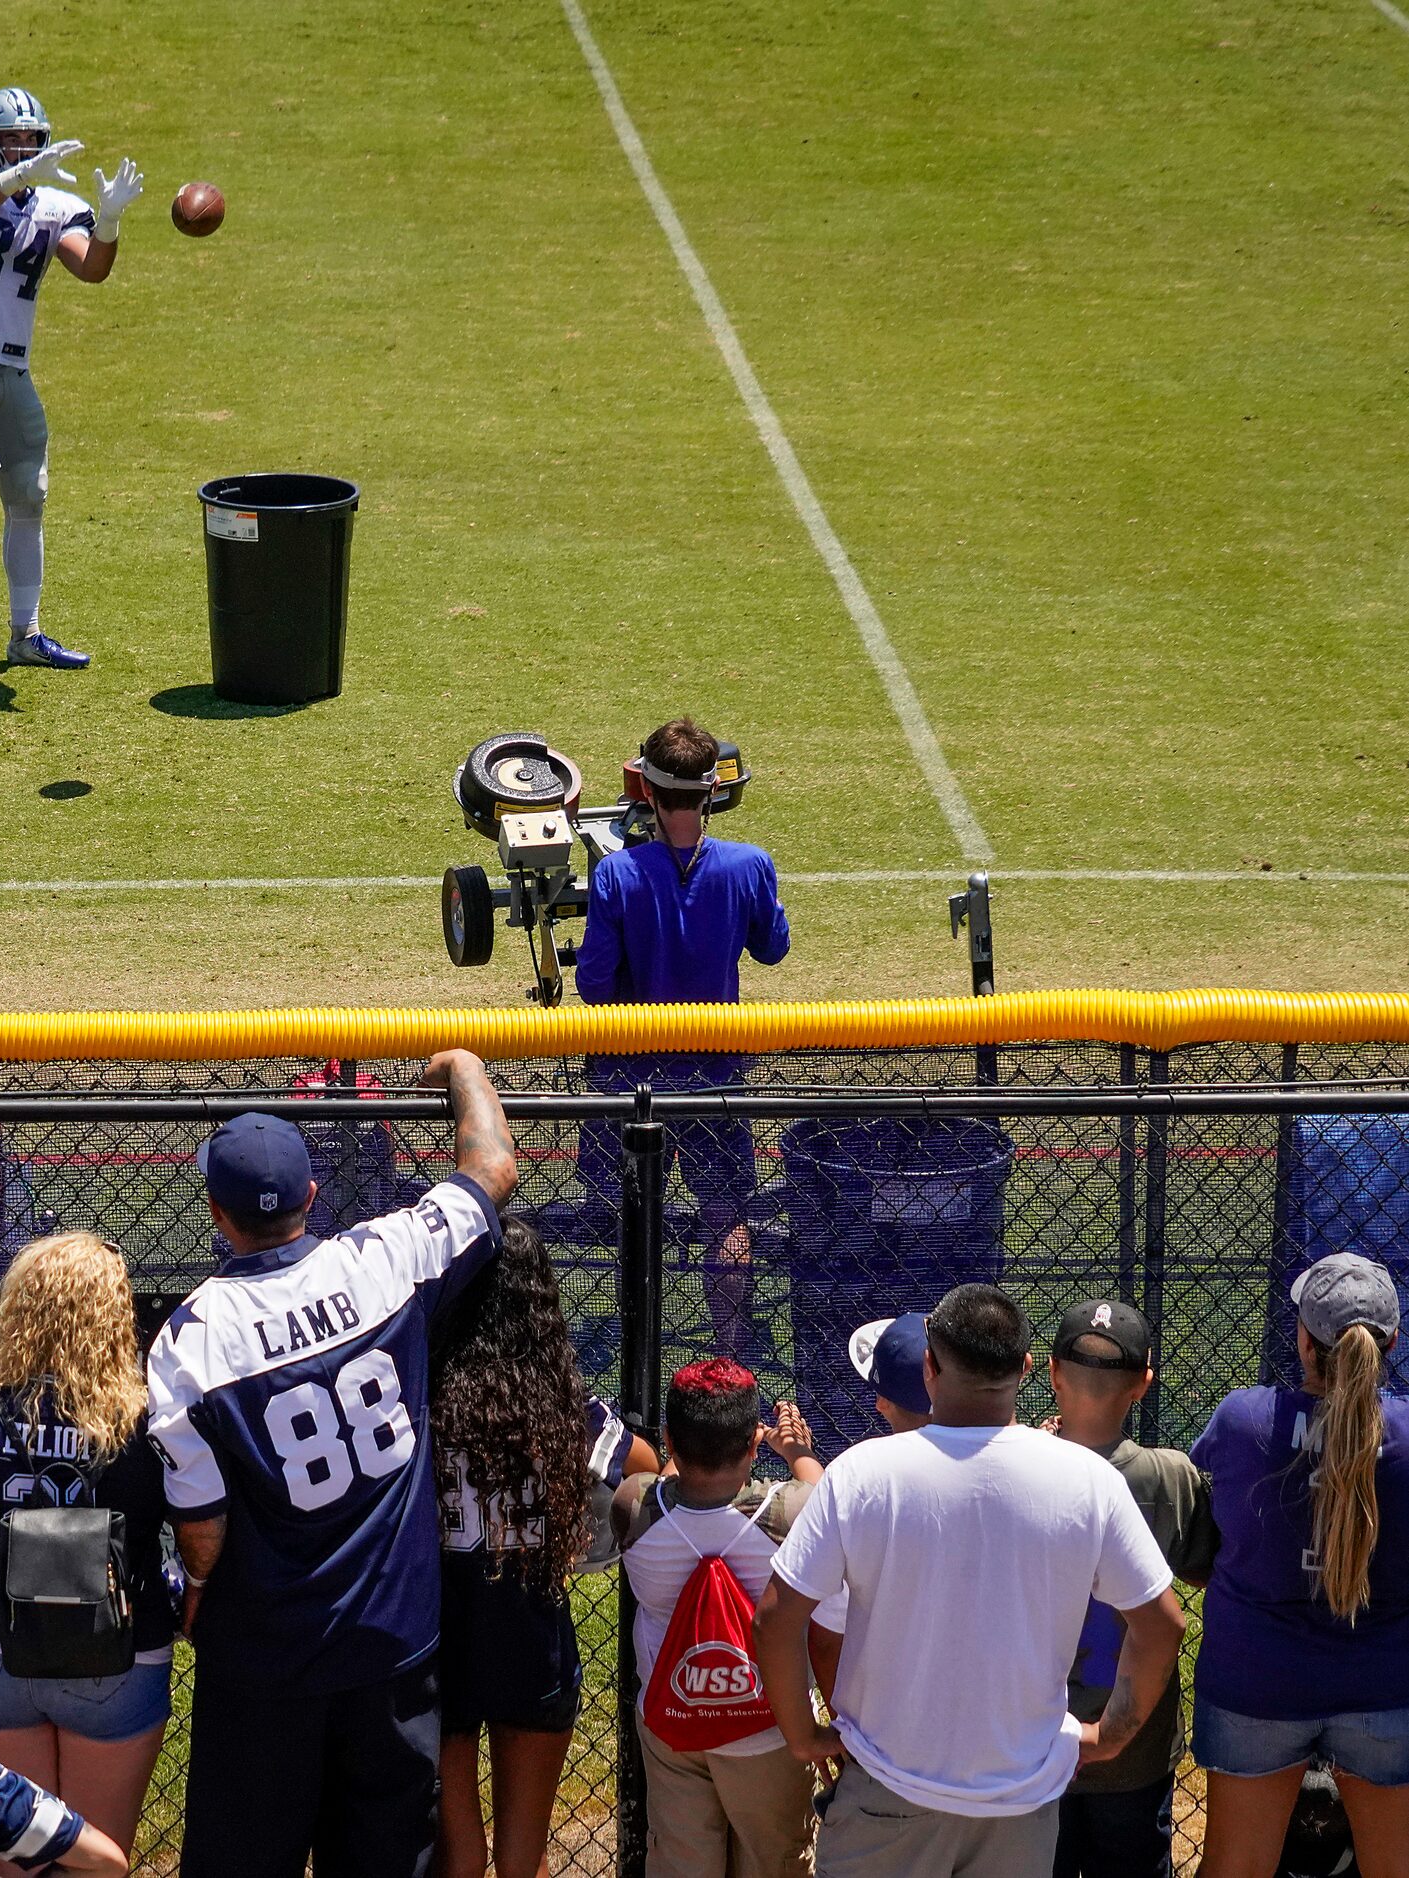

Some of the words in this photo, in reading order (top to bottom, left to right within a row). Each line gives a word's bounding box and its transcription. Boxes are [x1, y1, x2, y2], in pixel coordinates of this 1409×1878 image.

[253, 1291, 361, 1359] LAMB
[263, 1348, 416, 1512] 88
[684, 1663, 750, 1694] WSS
